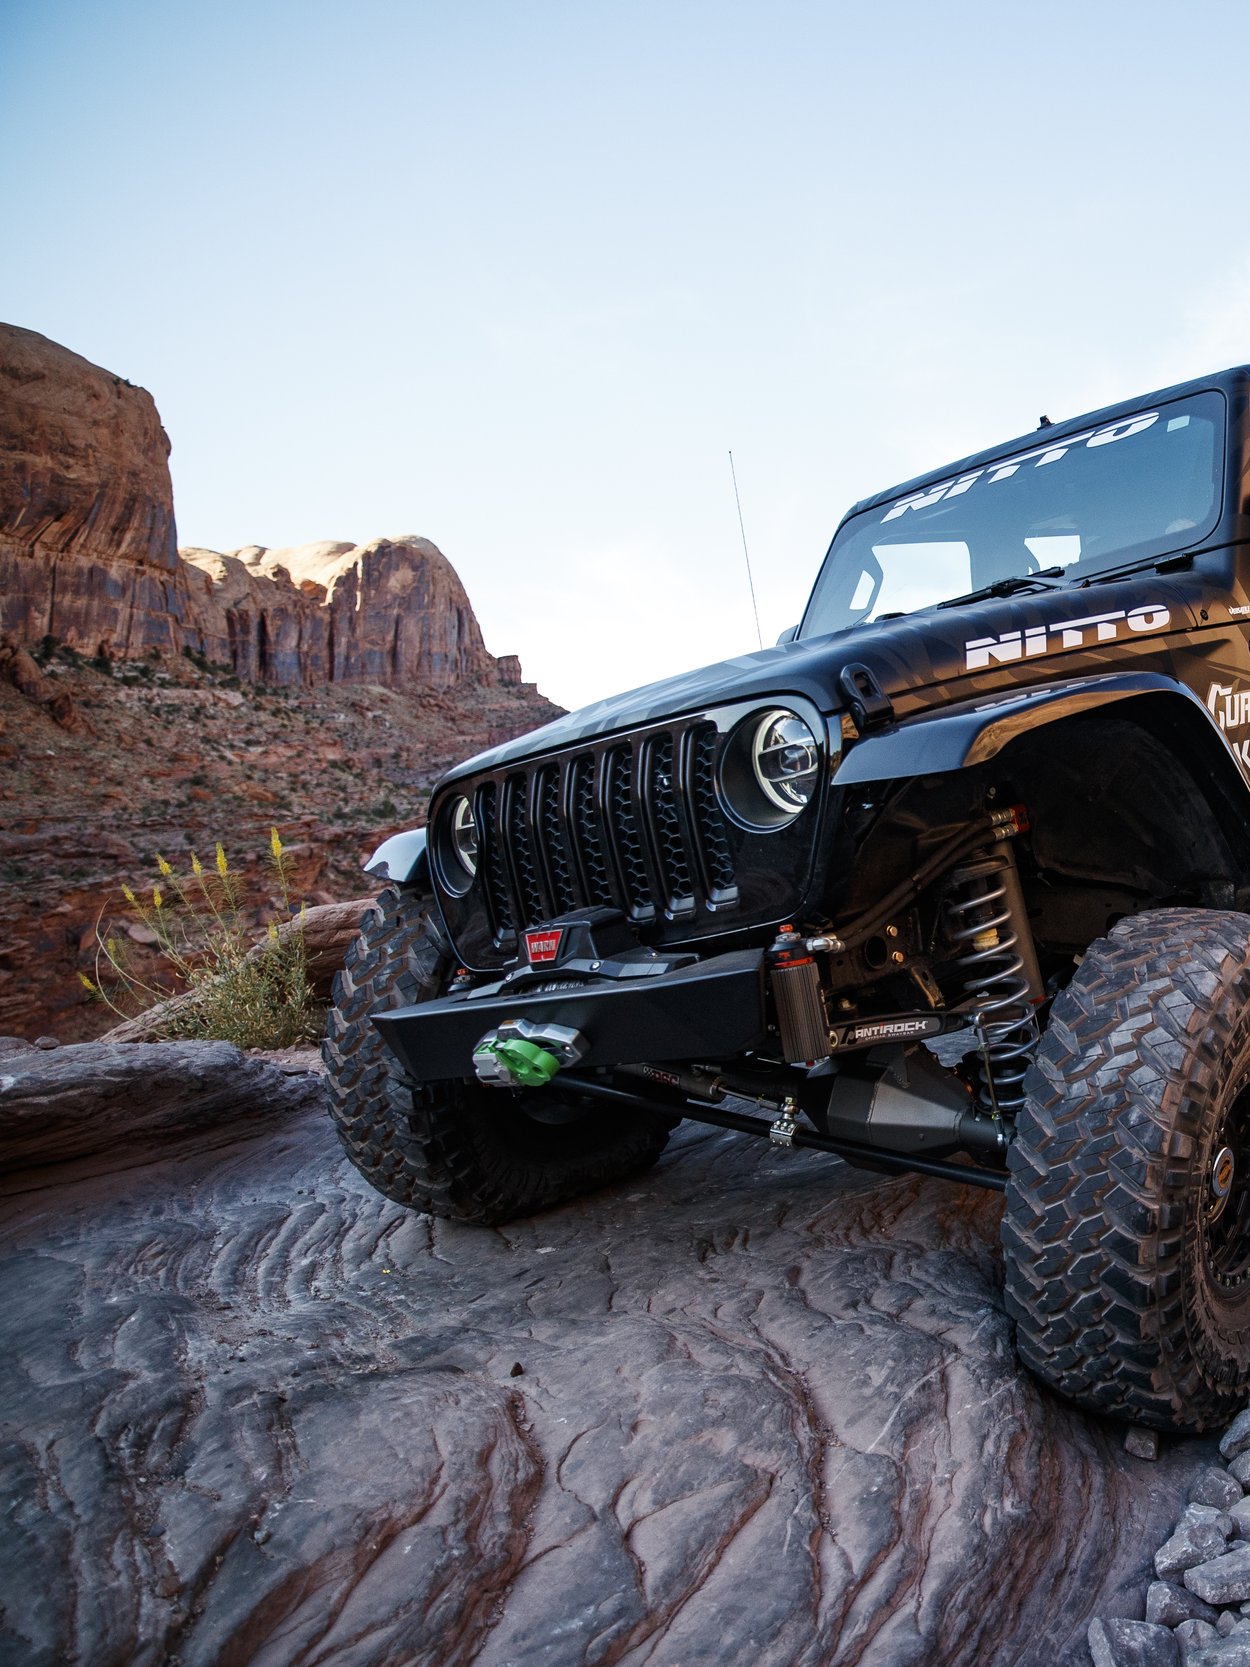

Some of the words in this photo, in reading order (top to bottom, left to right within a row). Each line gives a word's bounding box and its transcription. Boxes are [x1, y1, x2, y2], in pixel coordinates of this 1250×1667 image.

[881, 412, 1160, 524] NITTO
[965, 604, 1171, 670] NITTO
[530, 940, 556, 953] WARN
[855, 1021, 927, 1039] ANTIROCK
